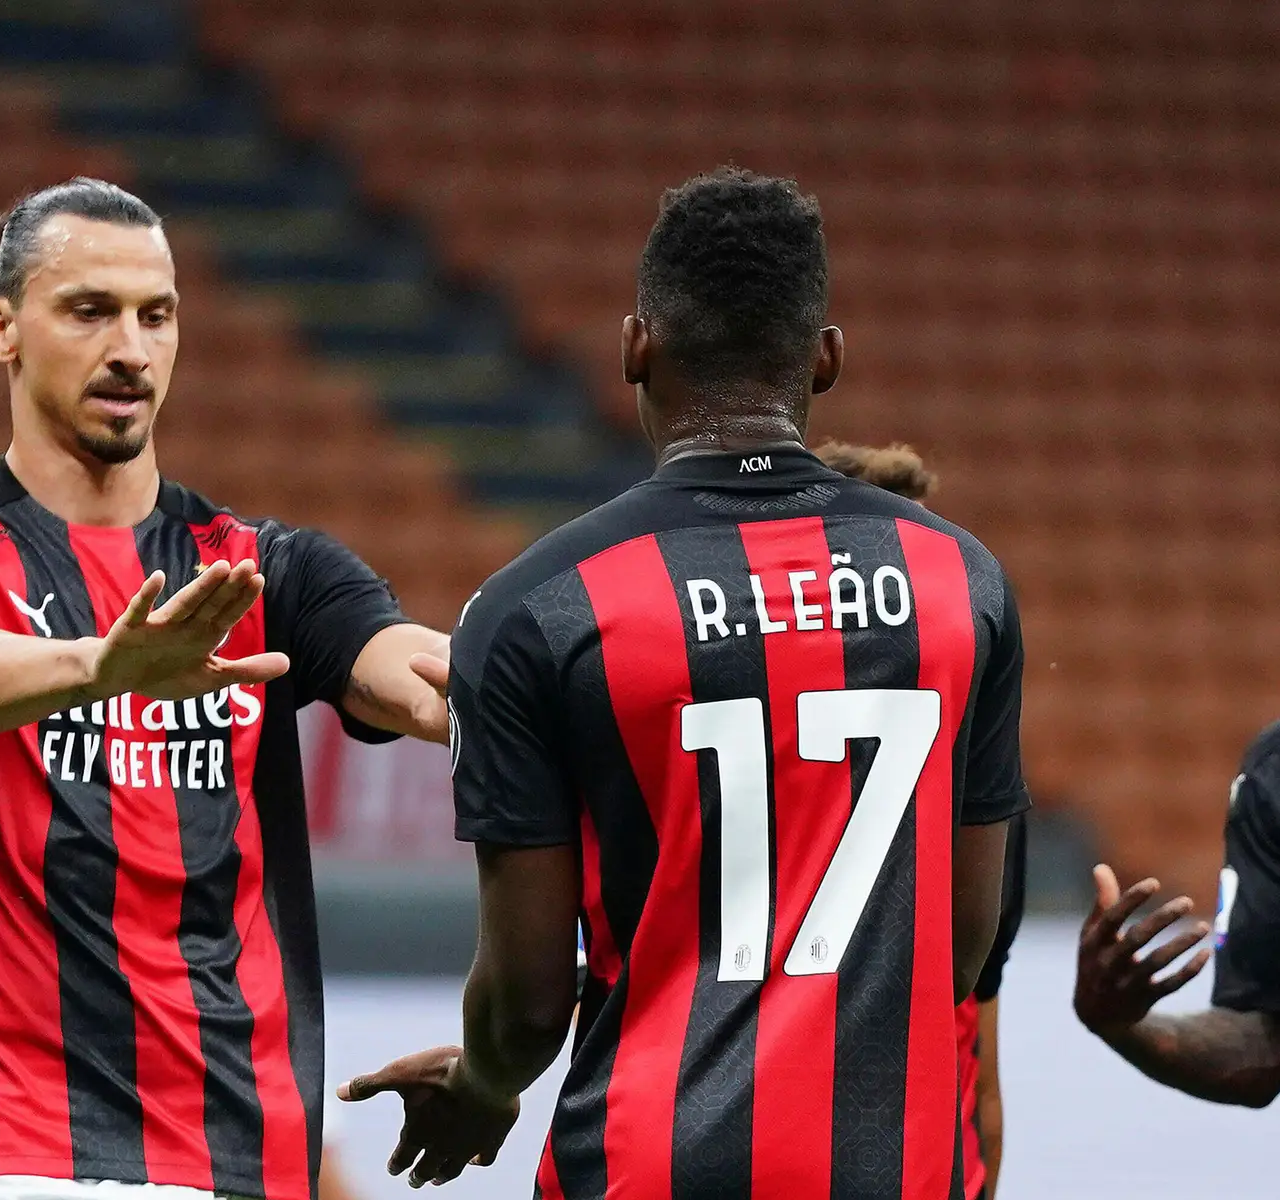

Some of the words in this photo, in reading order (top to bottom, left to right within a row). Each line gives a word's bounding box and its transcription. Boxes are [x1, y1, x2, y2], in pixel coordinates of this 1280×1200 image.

[739, 455, 773, 473] ACM
[686, 553, 912, 641] R.LEÃO
[48, 682, 262, 732] irates
[43, 730, 102, 783] FLY
[110, 738, 226, 790] BETTER
[681, 689, 941, 981] 17
